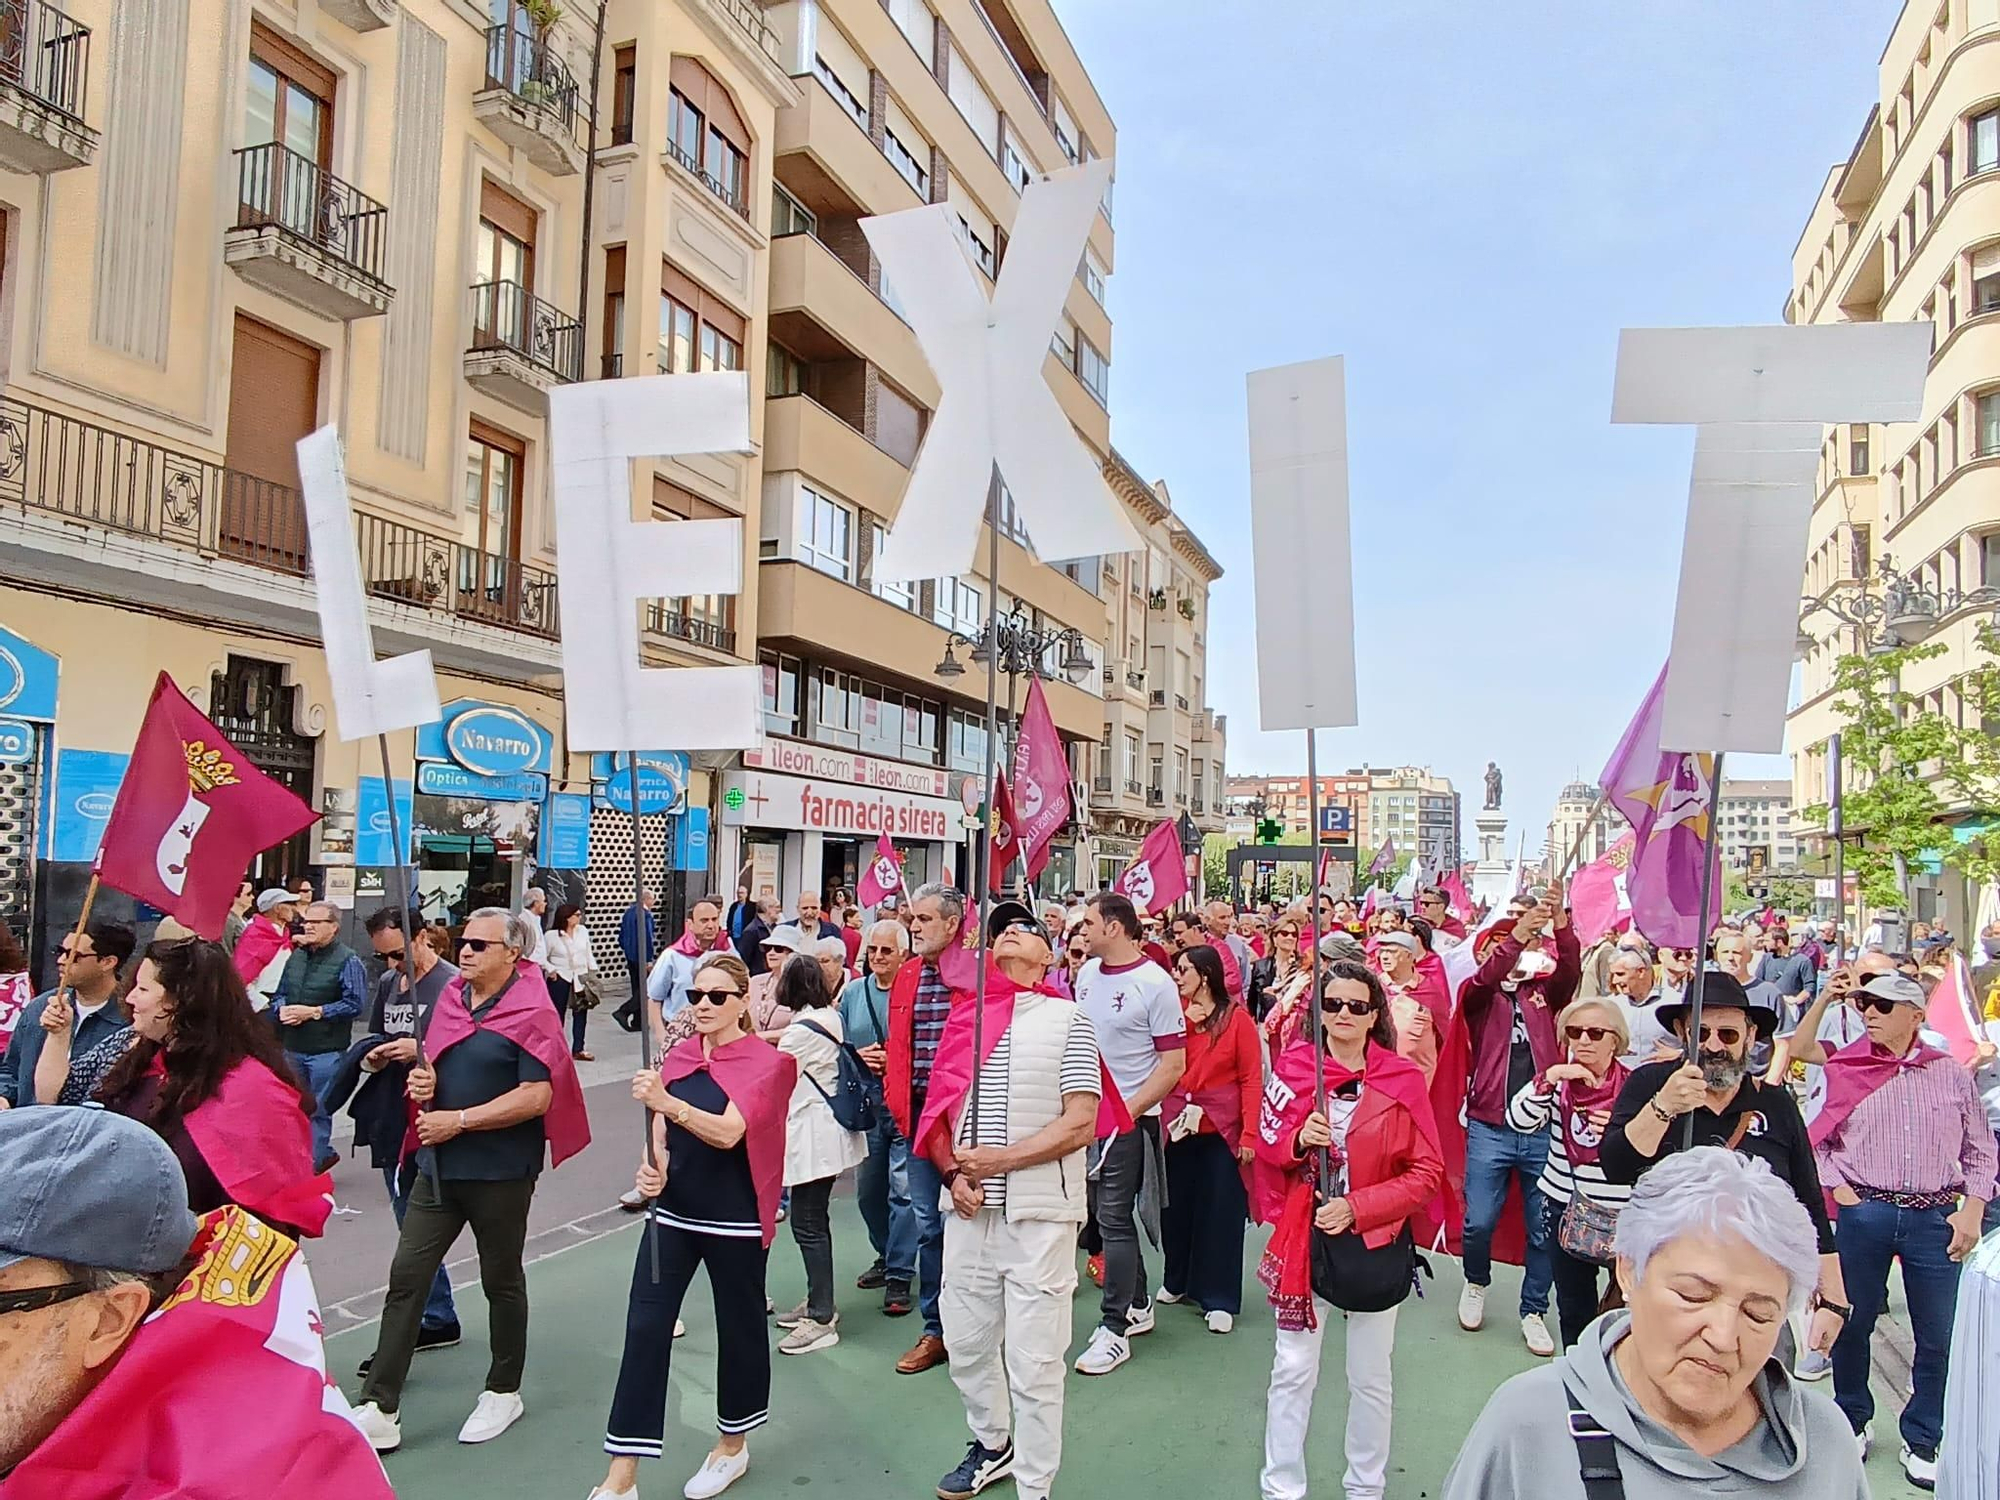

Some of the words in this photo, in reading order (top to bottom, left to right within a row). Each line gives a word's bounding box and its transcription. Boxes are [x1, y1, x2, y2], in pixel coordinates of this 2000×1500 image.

[461, 727, 531, 757] Navarro
[612, 786, 670, 801] Naarro
[800, 784, 894, 832] farmacia
[899, 799, 946, 837] sirera
[1327, 809, 1342, 830] P
[360, 877, 382, 888] SMH
